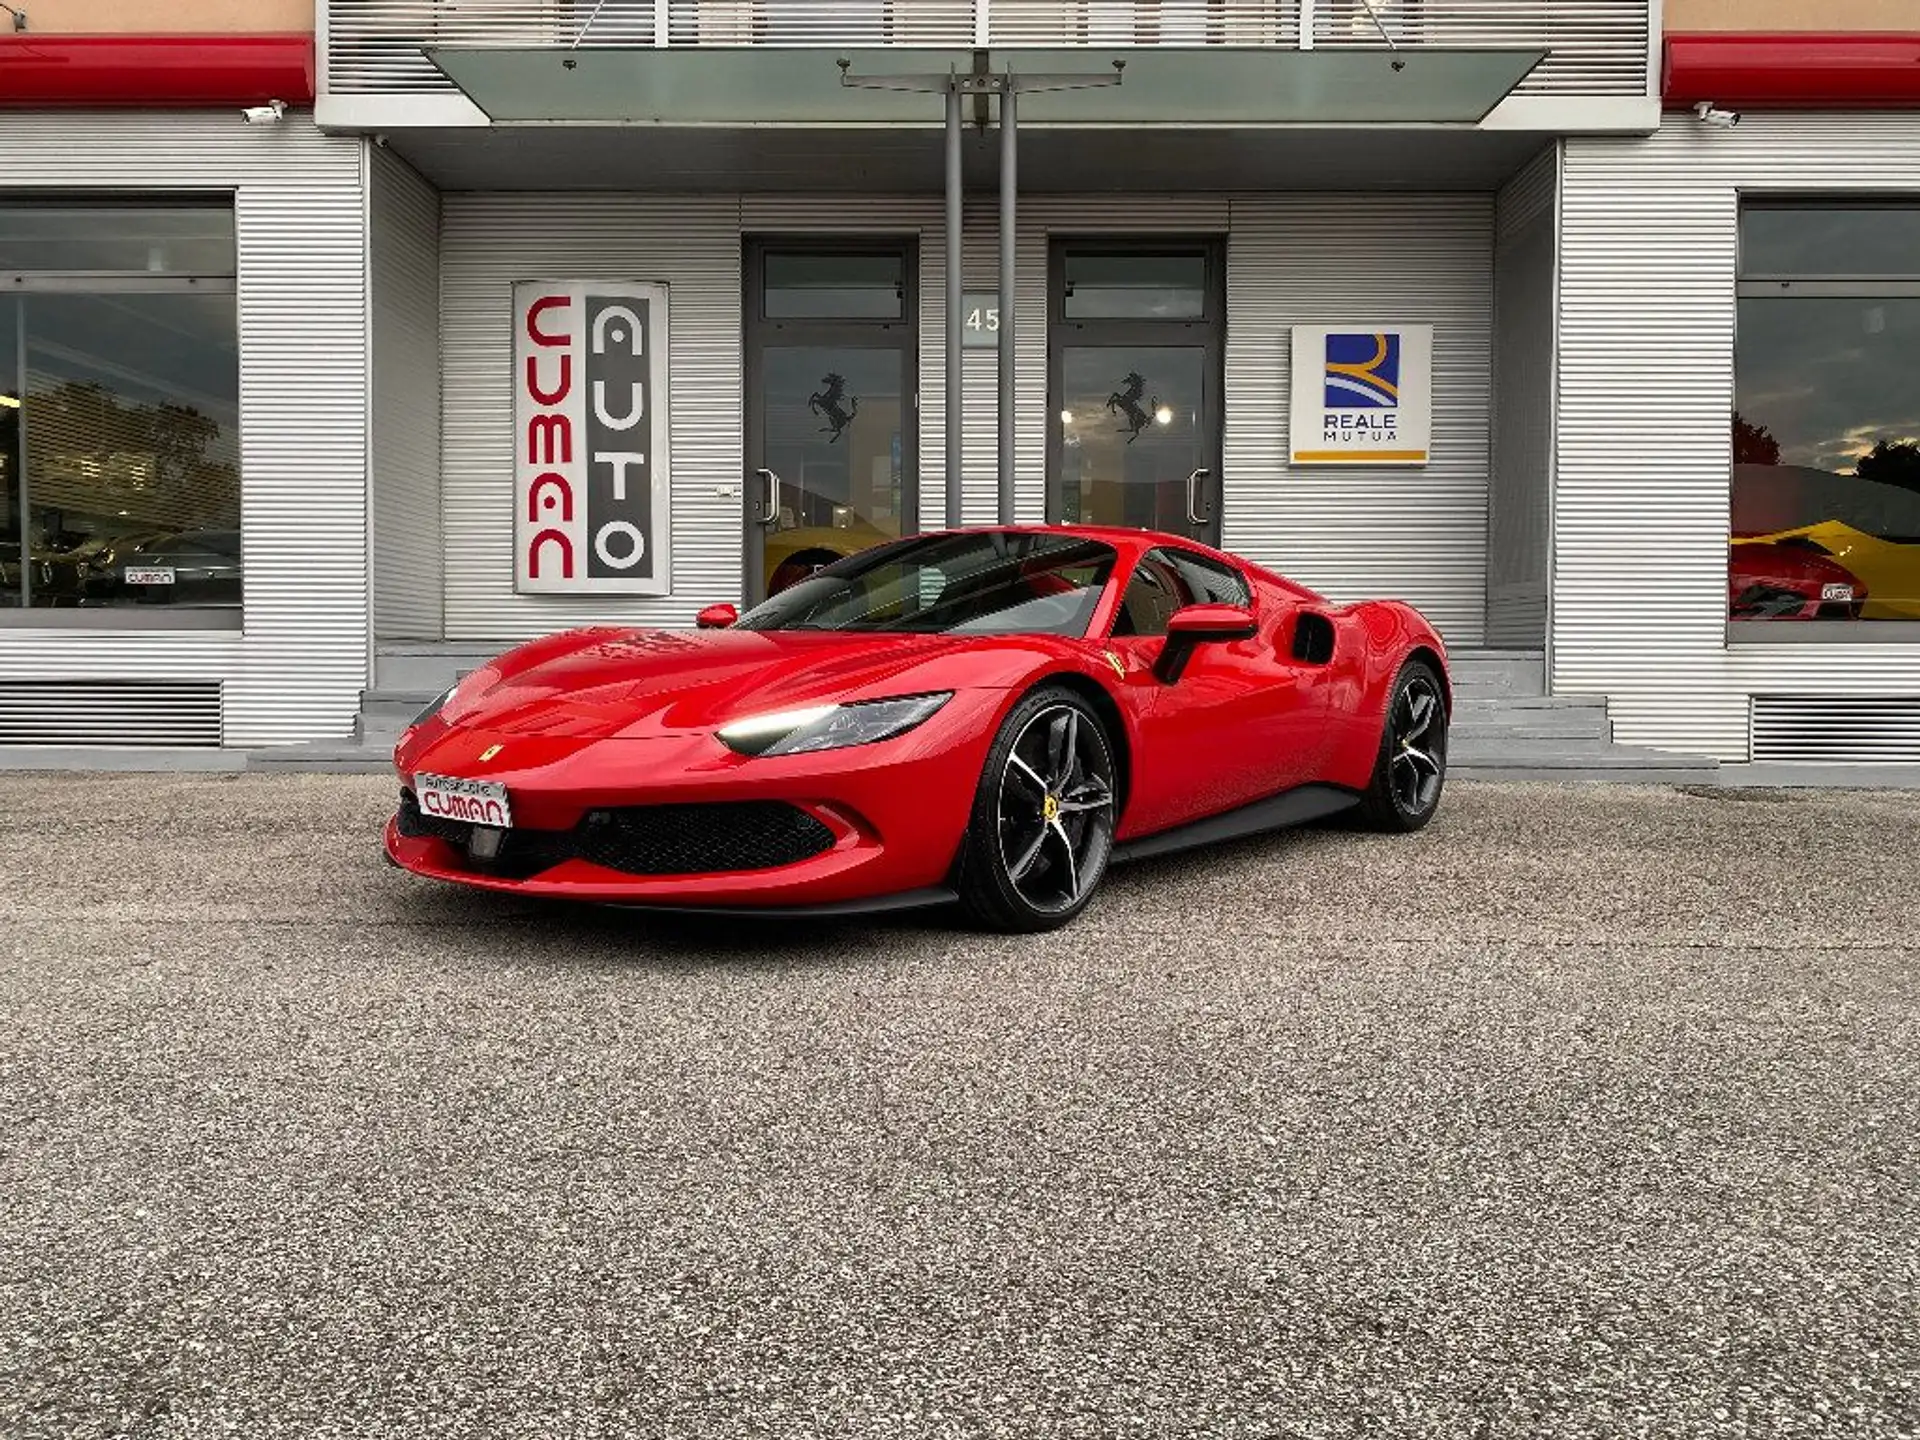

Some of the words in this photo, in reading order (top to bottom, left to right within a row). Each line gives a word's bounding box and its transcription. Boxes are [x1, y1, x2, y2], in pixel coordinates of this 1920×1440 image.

[966, 308, 1000, 332] 45
[1324, 414, 1398, 429] REALE
[527, 296, 573, 579] CUMAN
[592, 304, 646, 570] AUTO
[1323, 431, 1397, 442] MUTUA
[423, 791, 504, 824] CUMAN
